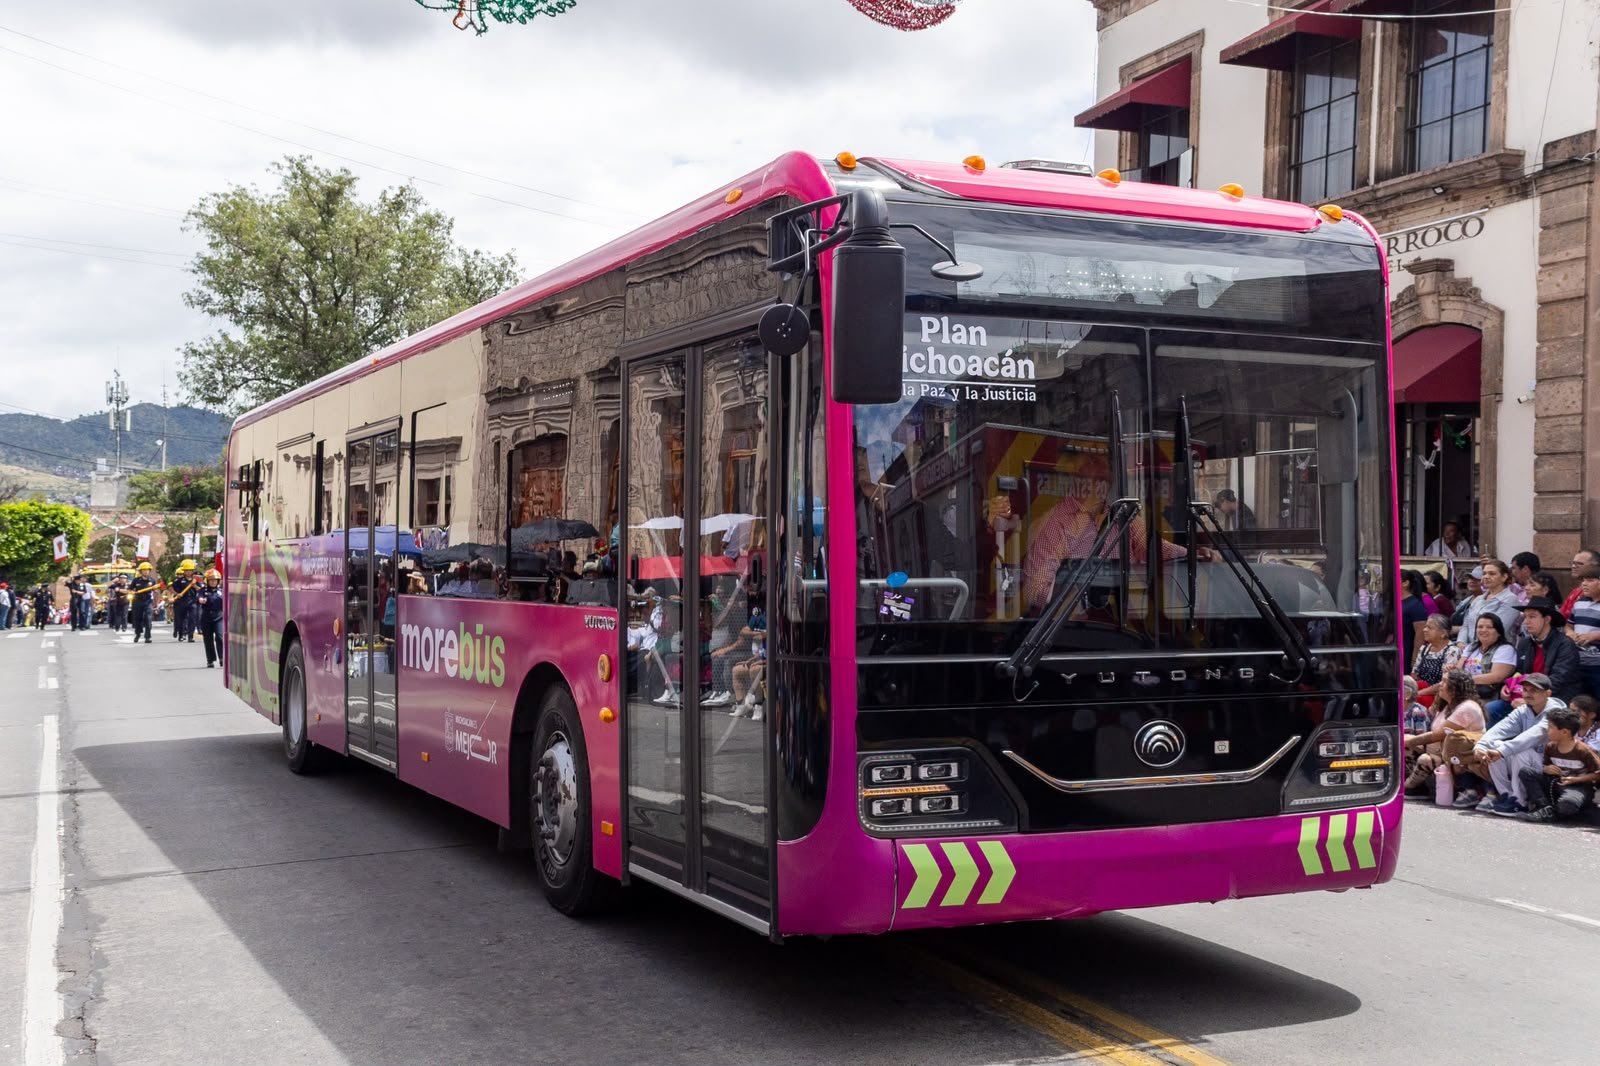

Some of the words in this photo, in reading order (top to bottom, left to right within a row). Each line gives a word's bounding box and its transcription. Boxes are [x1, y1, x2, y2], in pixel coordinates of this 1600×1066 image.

[1387, 216, 1485, 257] RROCO
[920, 316, 987, 346] Plan
[903, 346, 1035, 379] ichoacán
[903, 383, 915, 397] la
[920, 384, 945, 398] Paz
[951, 386, 960, 402] y
[965, 386, 978, 400] la
[981, 387, 1036, 402] Justicia
[1060, 667, 1255, 685] YUTONG
